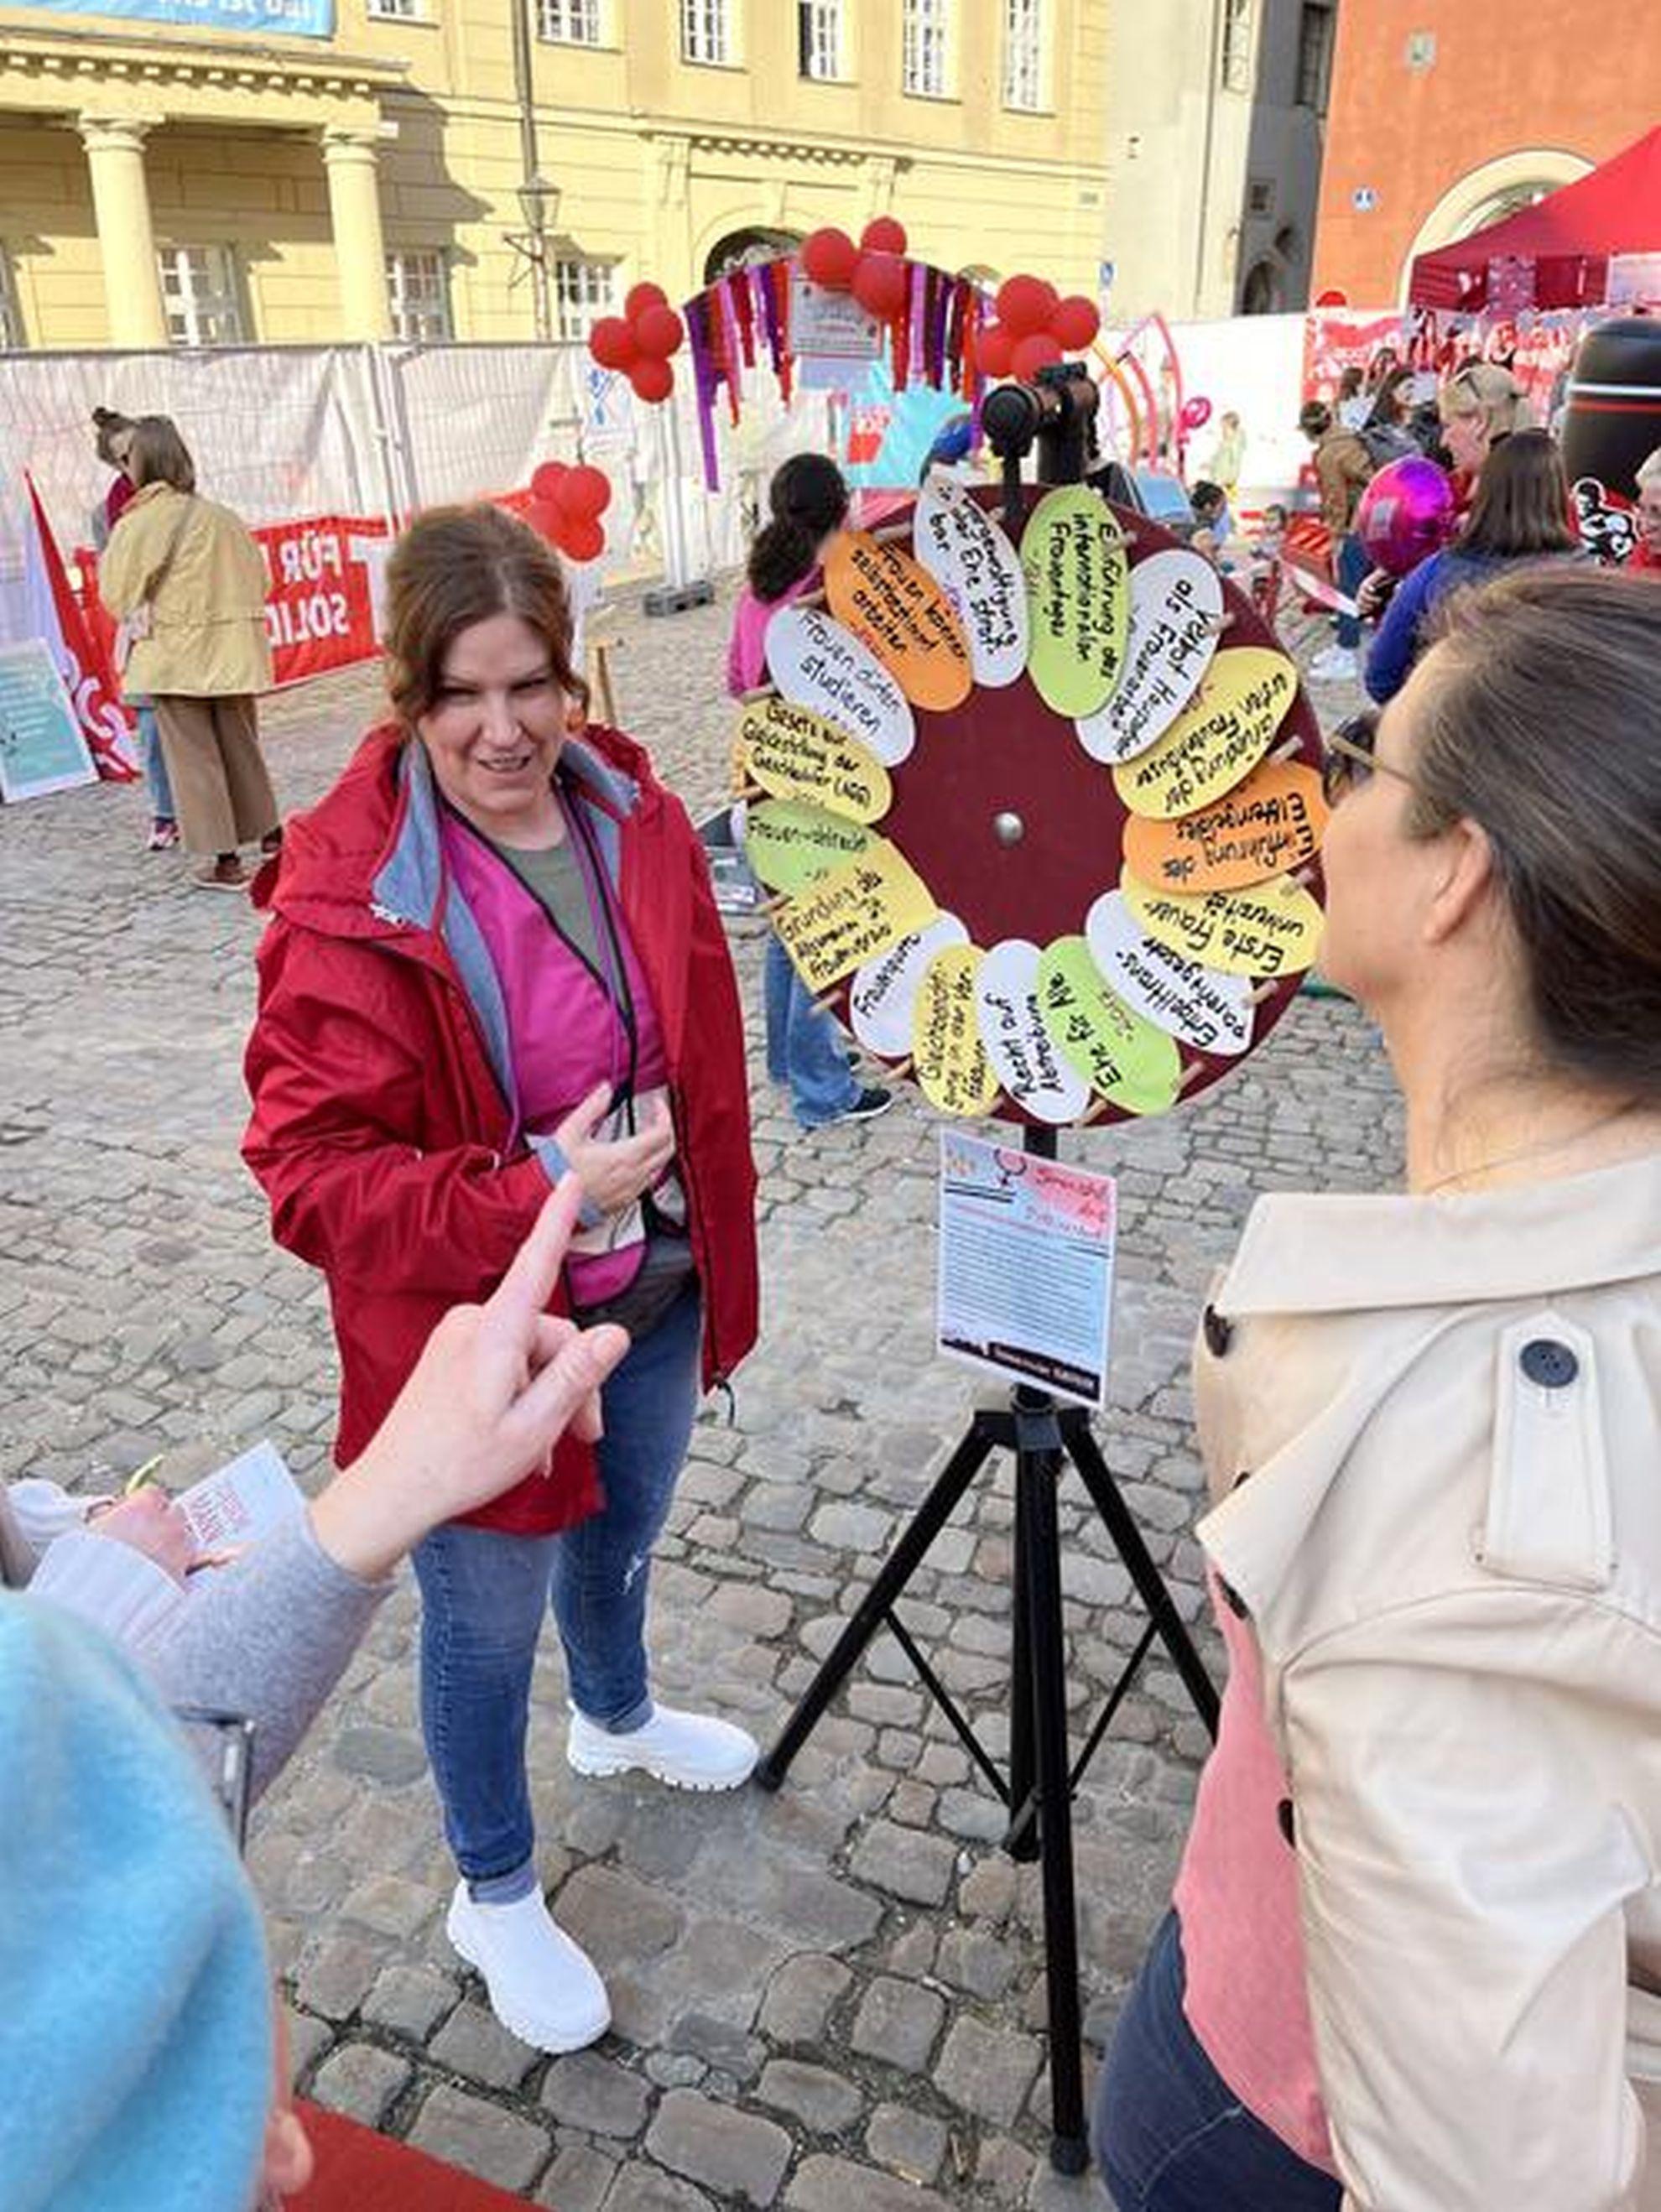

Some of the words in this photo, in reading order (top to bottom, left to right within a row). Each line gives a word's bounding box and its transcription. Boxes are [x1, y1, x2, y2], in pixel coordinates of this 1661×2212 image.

[929, 513, 951, 552] bar
[959, 546, 995, 590] Ehe
[1165, 579, 1194, 614] als
[799, 605, 855, 671] Frauen
[851, 589, 908, 654] arbeiten
[1100, 646, 1119, 679] des
[799, 654, 882, 736] studieren
[1165, 778, 1195, 814] der
[1222, 929, 1285, 974] Erste
[1046, 972, 1076, 1010] Alle
[983, 992, 1018, 1031] auf
[1065, 1014, 1096, 1043] für
[1089, 1042, 1122, 1090] Ehe
